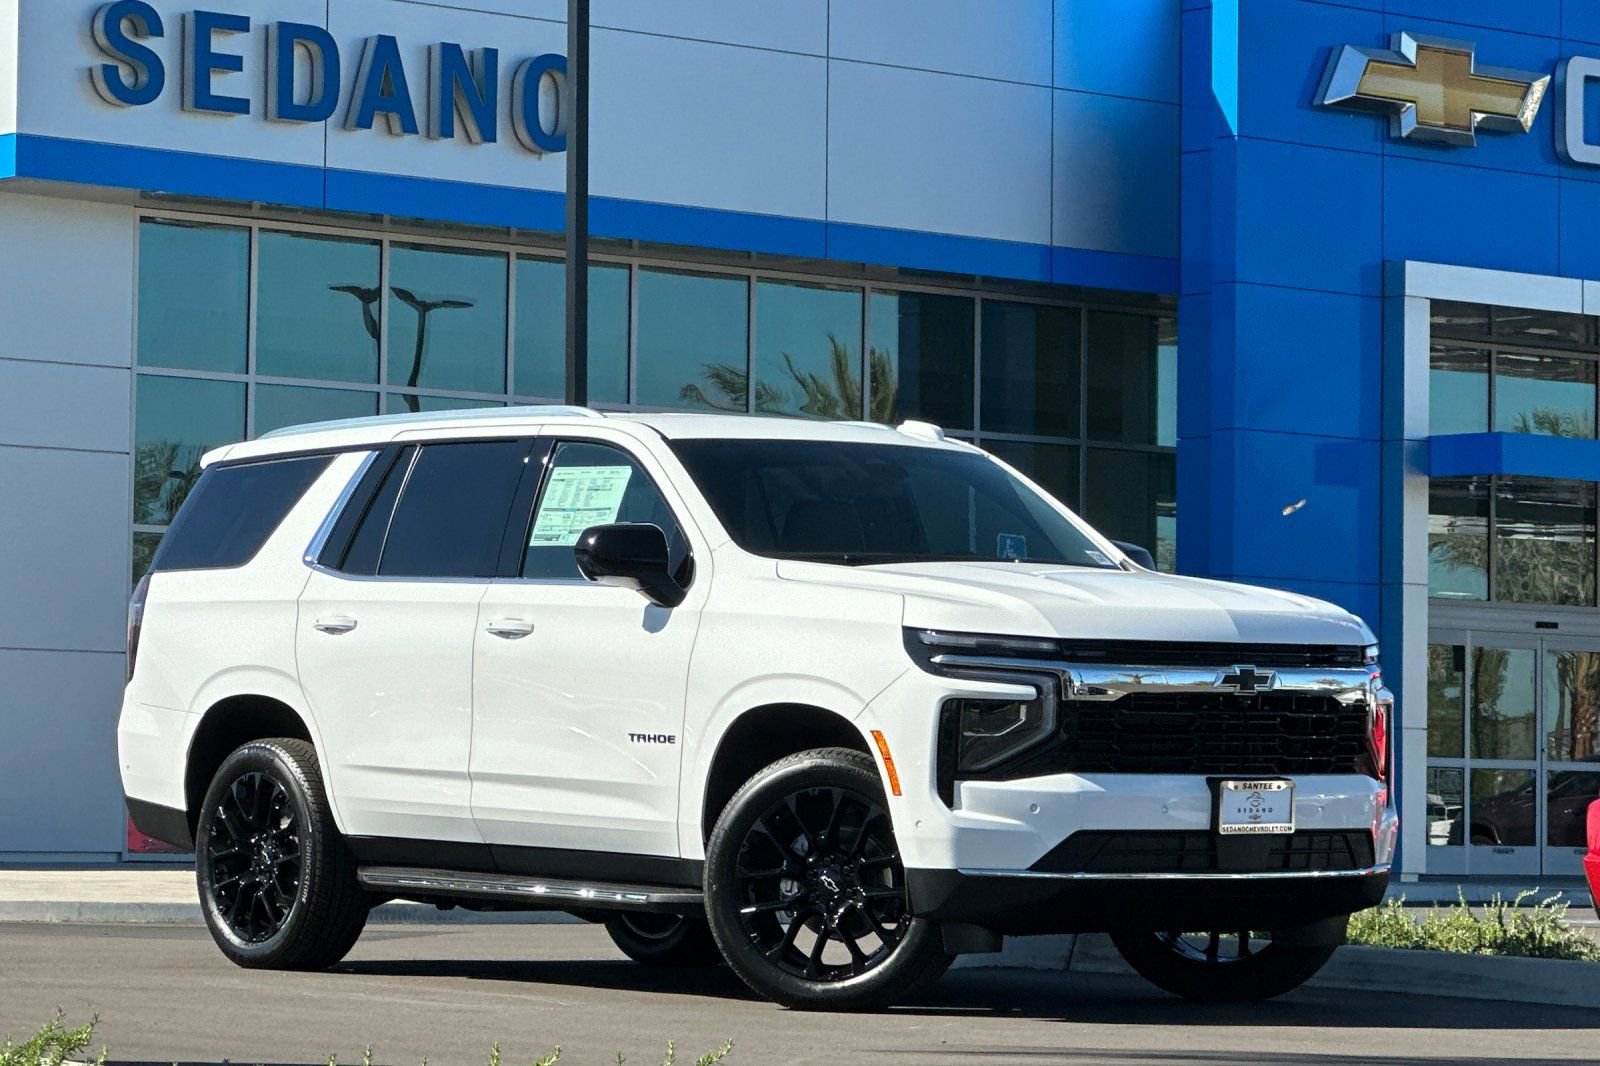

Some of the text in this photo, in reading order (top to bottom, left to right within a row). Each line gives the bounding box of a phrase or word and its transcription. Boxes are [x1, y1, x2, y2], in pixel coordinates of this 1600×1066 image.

[95, 0, 568, 156] SEDANO
[628, 733, 676, 744] TAHOE
[1241, 782, 1273, 790] SANTEE
